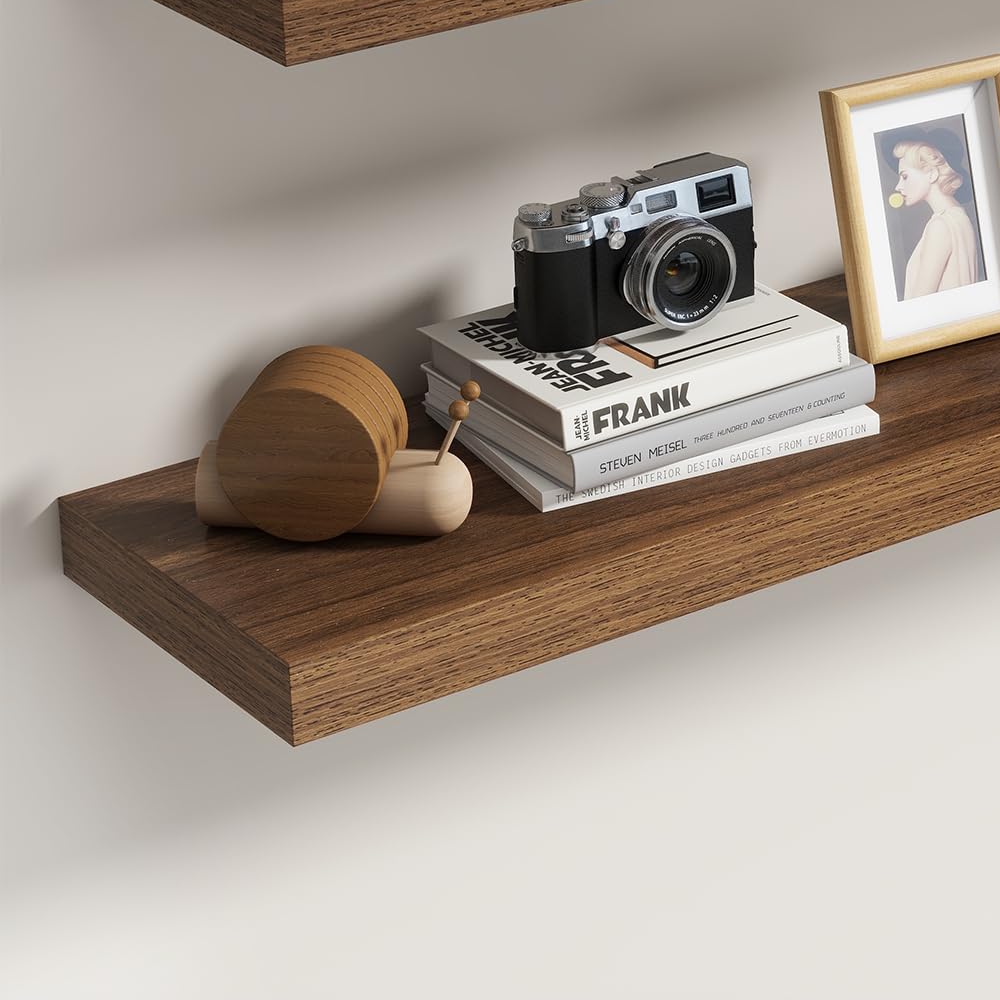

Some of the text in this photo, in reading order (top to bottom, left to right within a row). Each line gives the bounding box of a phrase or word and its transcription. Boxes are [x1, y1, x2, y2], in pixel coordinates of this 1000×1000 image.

[581, 409, 590, 442] MICHEL
[592, 382, 691, 435] FRANK
[599, 452, 642, 474] STEVEN
[648, 440, 688, 459] MEISEL
[694, 431, 714, 443] THREE
[717, 422, 748, 437] HUNDRED
[750, 417, 765, 427] AND
[767, 405, 804, 422] SEVENTEEN
[813, 392, 846, 408] COUNTING
[556, 423, 867, 505] THE SWEDISH INTERIOR DESIGN GADGETS FROM EVERMOTION
